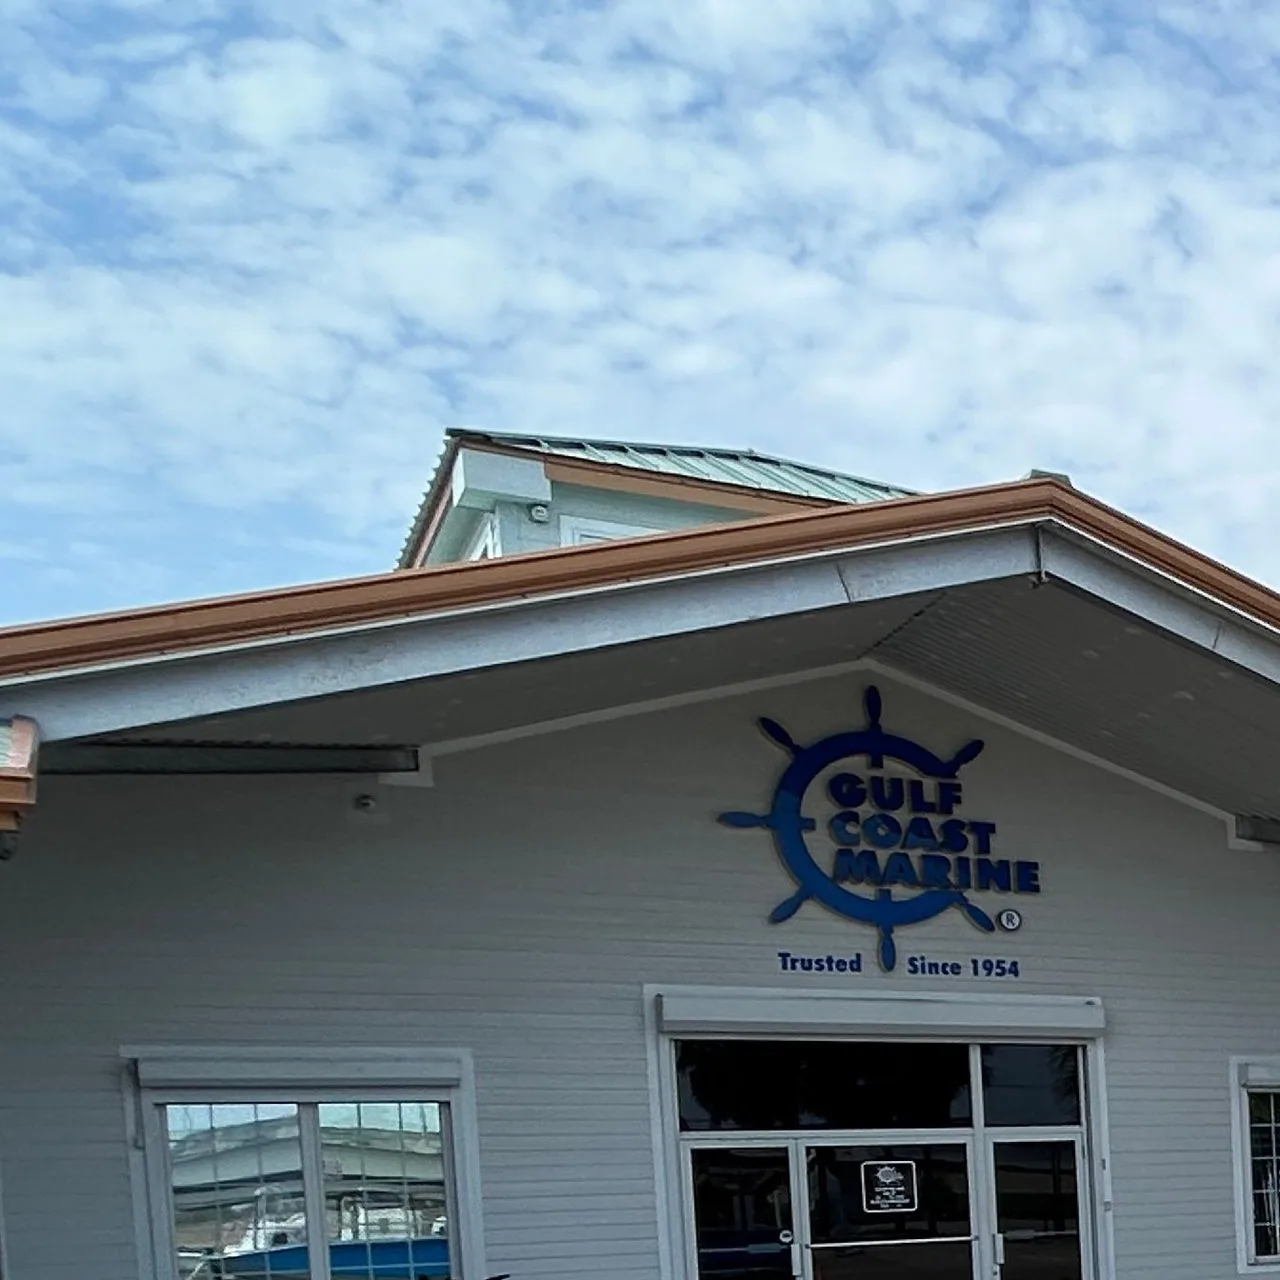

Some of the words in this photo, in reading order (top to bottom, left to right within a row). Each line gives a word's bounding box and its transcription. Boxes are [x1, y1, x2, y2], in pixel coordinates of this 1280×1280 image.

[827, 772, 962, 815] GULF
[828, 811, 996, 855] COAST
[833, 848, 1041, 893] MARINE
[778, 952, 862, 973] Trusted
[907, 955, 962, 976] Since
[971, 958, 1019, 978] 1954
